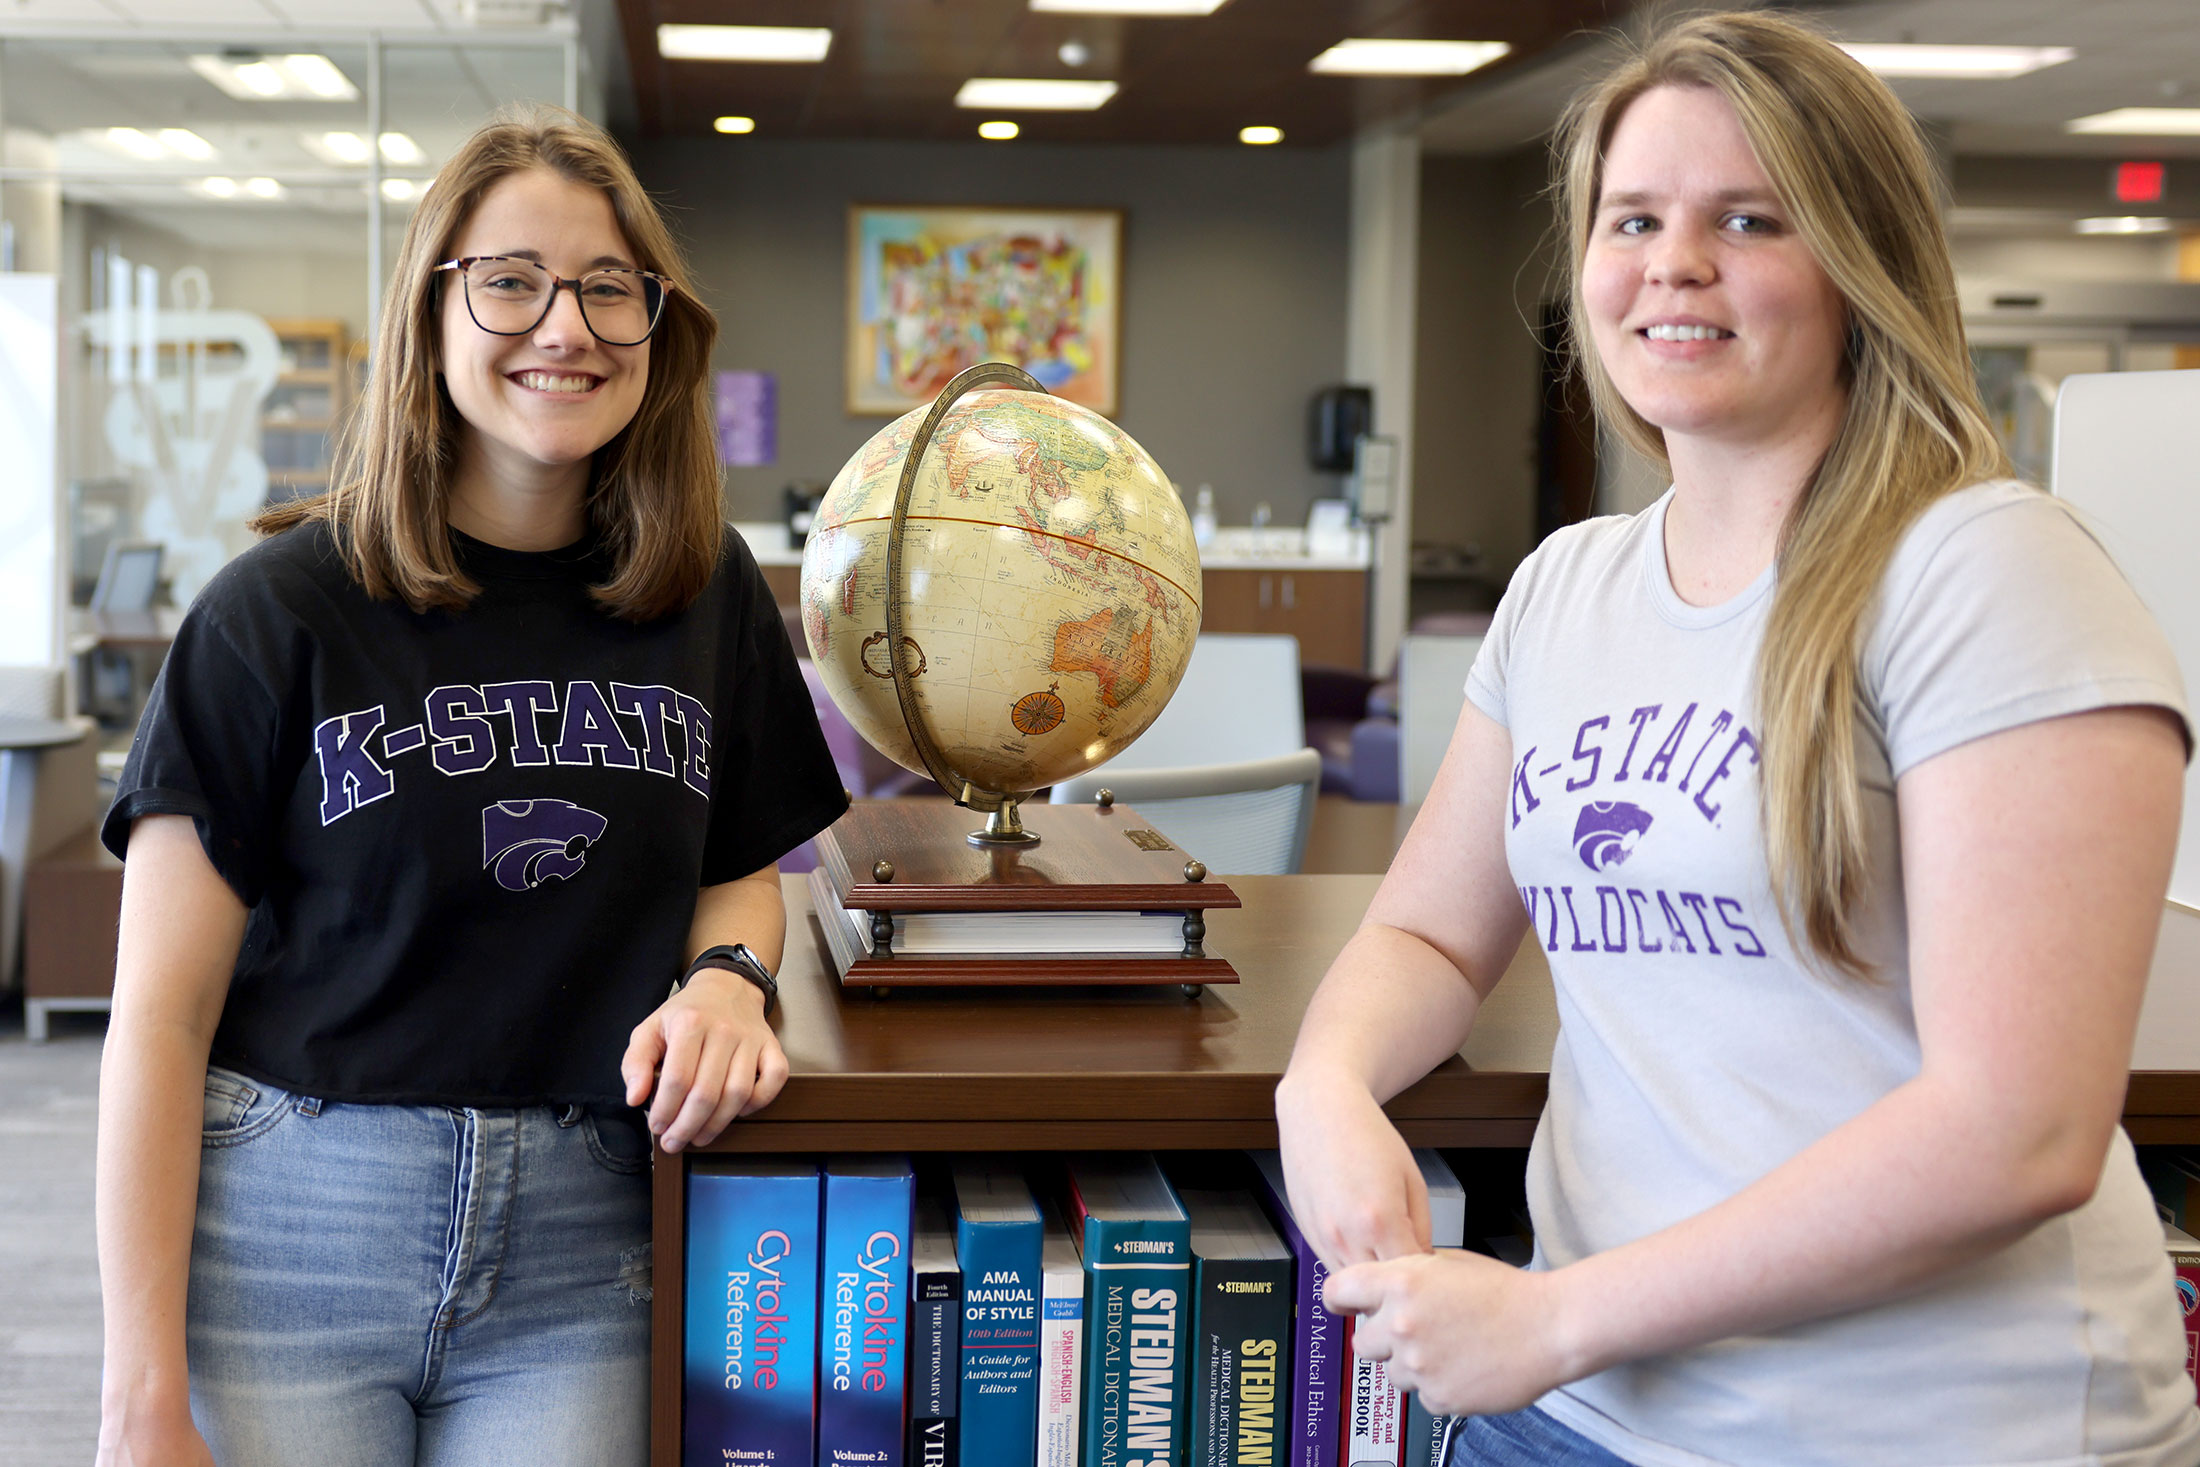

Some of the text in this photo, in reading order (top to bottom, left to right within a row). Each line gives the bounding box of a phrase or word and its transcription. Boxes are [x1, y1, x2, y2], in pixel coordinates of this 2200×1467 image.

[315, 680, 713, 827] K-STATE
[1512, 702, 1760, 831] K-STATE
[1518, 885, 1767, 958] WILDCATS
[1123, 1241, 1174, 1254] STEDMAN'S
[967, 1289, 1034, 1302] MANUAL
[982, 1271, 1020, 1284] AMA
[1225, 1281, 1272, 1294] STEDMAN'S
[747, 1229, 791, 1390] Cytokine
[857, 1231, 900, 1392] Cytokine
[966, 1307, 1034, 1320] OF STYLE
[1105, 1285, 1123, 1367] MEDICAL
[1311, 1305, 1327, 1321] of
[725, 1271, 750, 1390] Reference
[833, 1272, 859, 1391] Reference
[968, 1329, 1033, 1338] 10th Edition
[1210, 1333, 1220, 1343] for
[930, 1305, 942, 1415] THE DICTIONARY OF
[967, 1355, 1031, 1367] A Guide for
[1061, 1330, 1074, 1404] SPANISH-ENGLISH
[1211, 1345, 1219, 1355] the
[1309, 1324, 1327, 1386] Medical
[964, 1369, 1032, 1379] Authors and
[978, 1384, 1017, 1394] Editors
[1049, 1341, 1062, 1414] ENGLISH-SPANISH
[1210, 1356, 1219, 1387] HEALTH
[1220, 1348, 1232, 1402] MEDICAL
[1208, 1389, 1219, 1436] PROFESSIONS
[1306, 1390, 1325, 1438] Ethics
[1371, 1395, 1385, 1445] Medicine
[924, 1420, 945, 1467] VIR
[1064, 1414, 1073, 1451] Diccionario
[1207, 1438, 1215, 1454] AND
[1384, 1423, 1395, 1444] and
[722, 1449, 775, 1460] Volume 1:
[833, 1450, 888, 1461] Volume 2:
